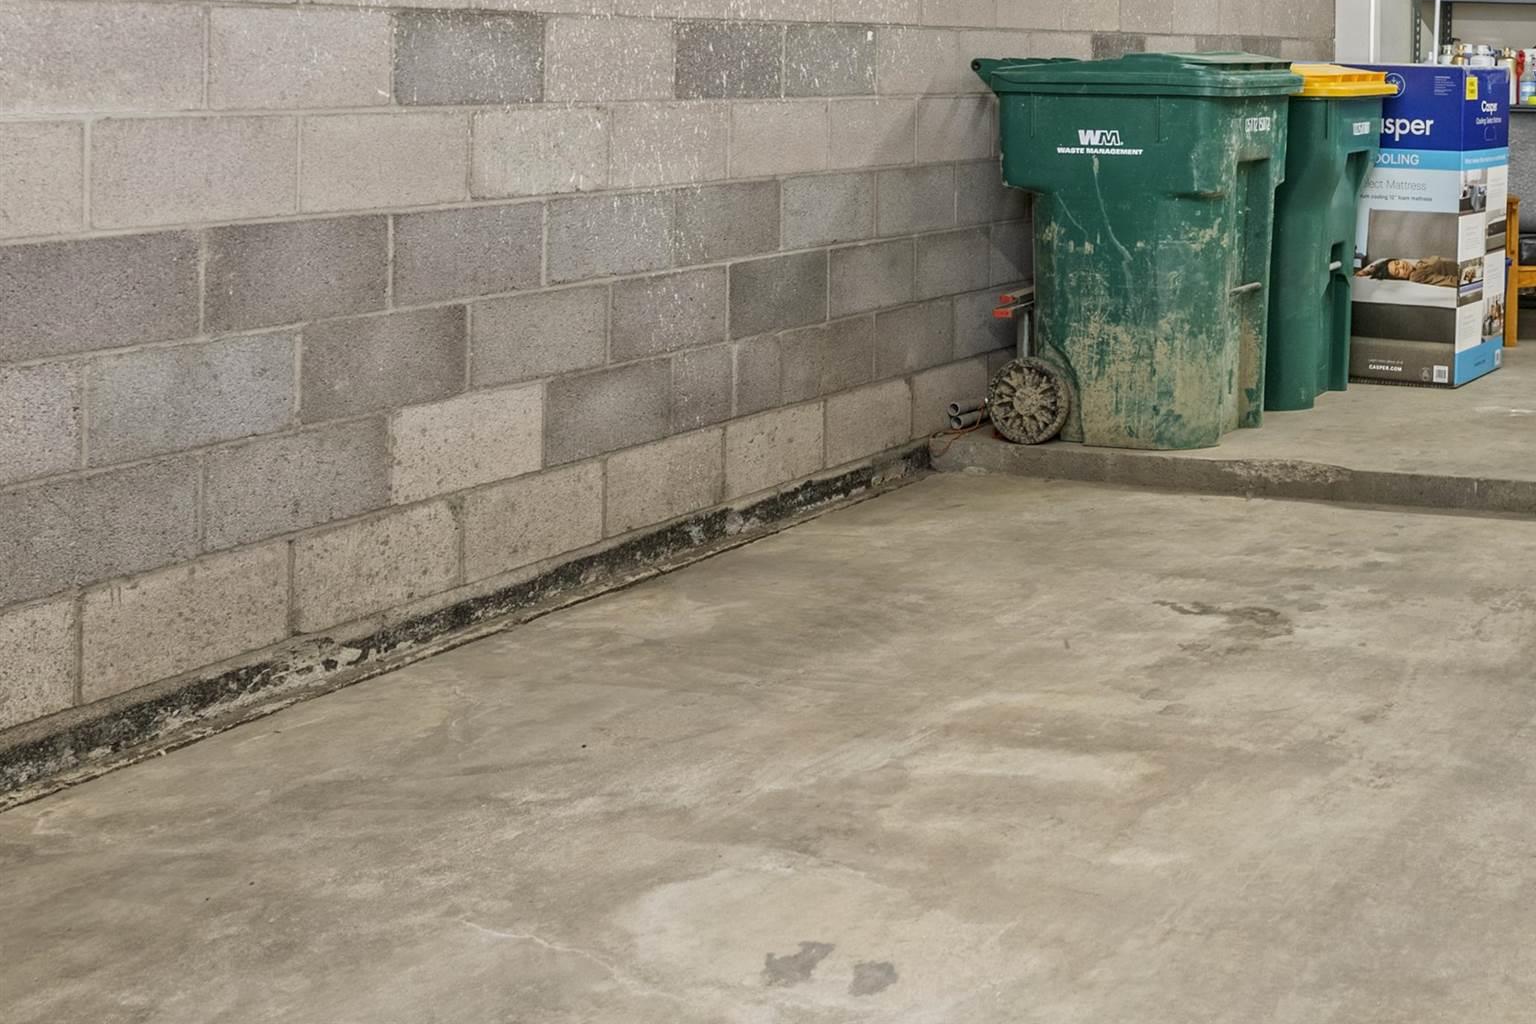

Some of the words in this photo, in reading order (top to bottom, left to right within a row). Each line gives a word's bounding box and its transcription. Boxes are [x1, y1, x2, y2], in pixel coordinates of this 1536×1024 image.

[1380, 117, 1434, 141] sper
[1078, 129, 1121, 146] WM
[1375, 152, 1420, 165] OLING
[1368, 364, 1402, 372] CASPER.COM
